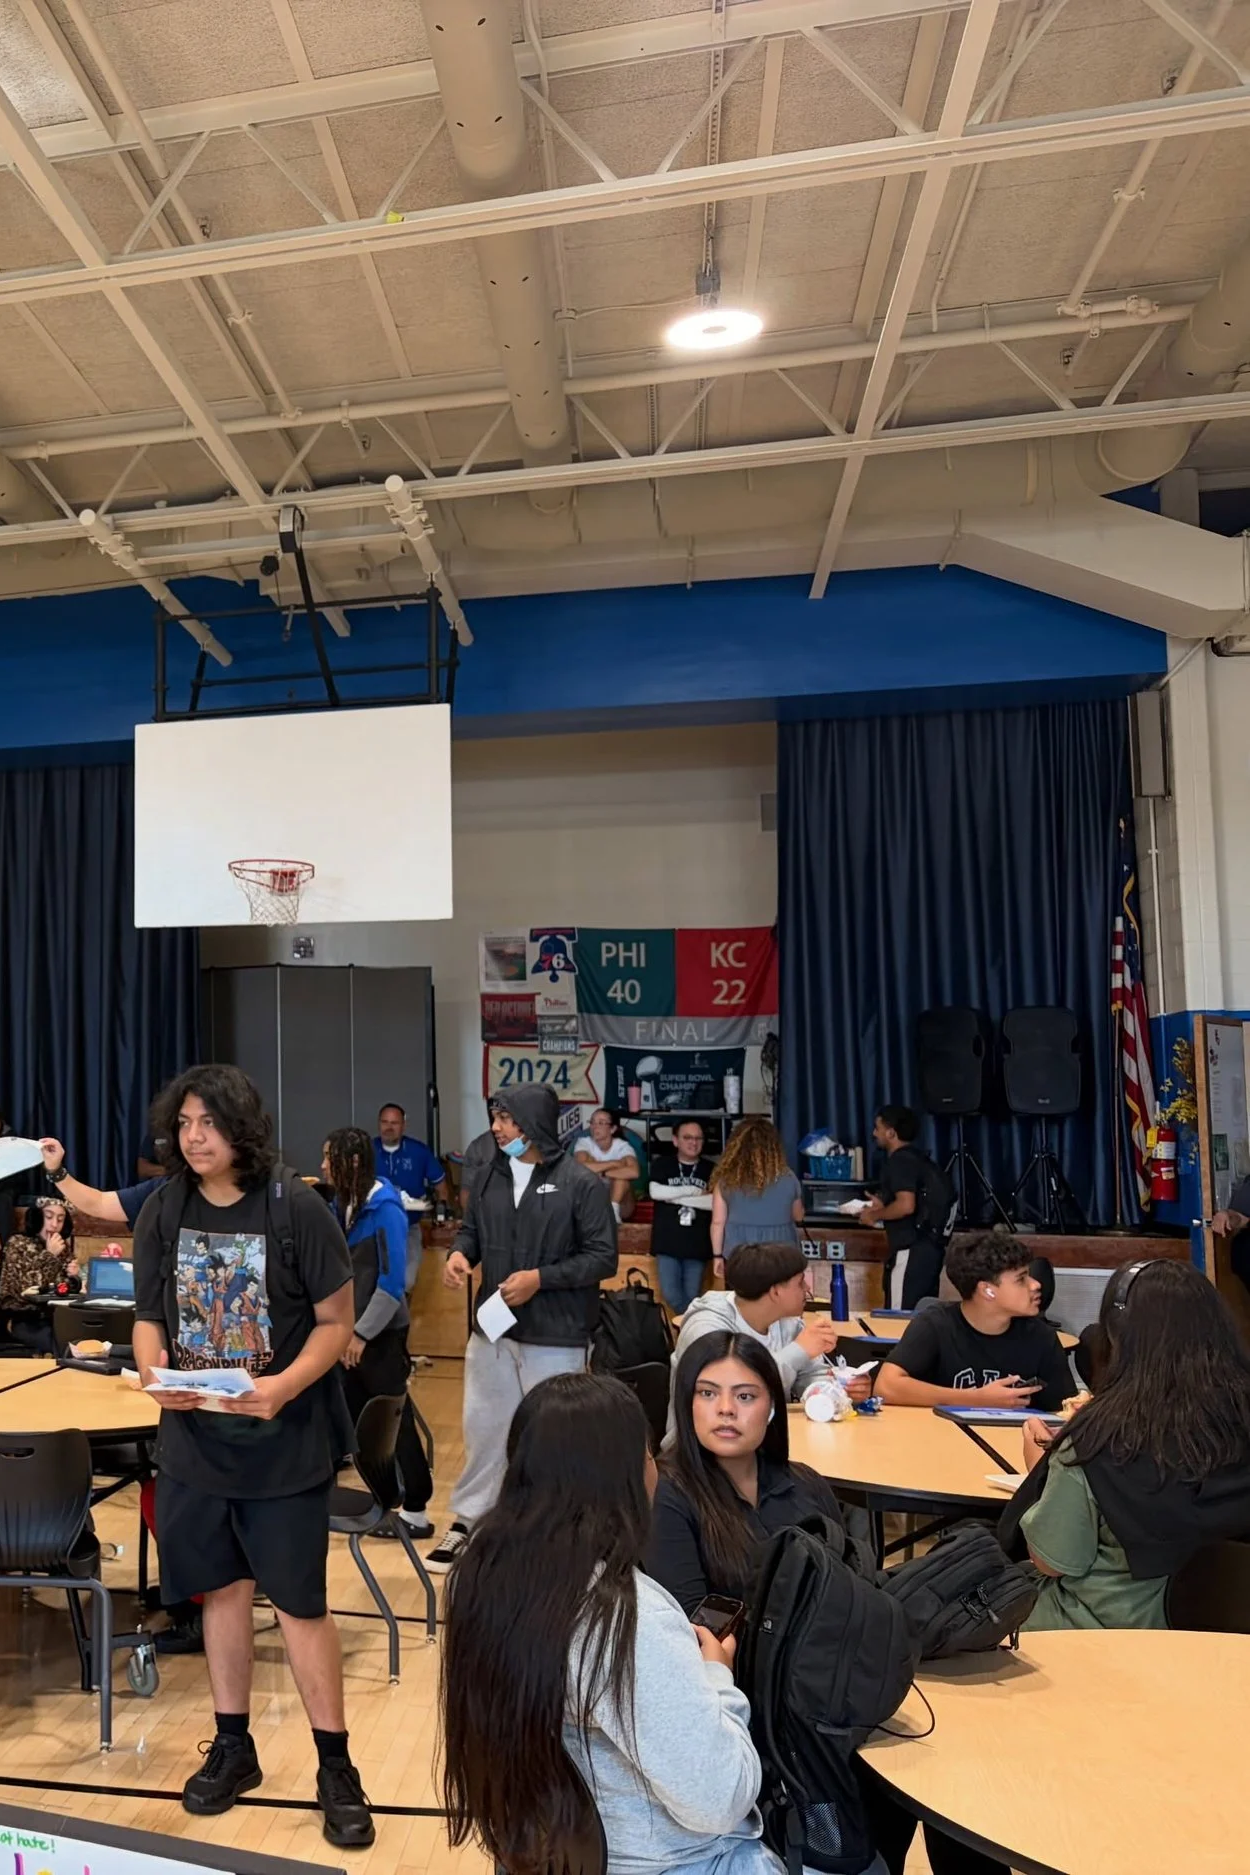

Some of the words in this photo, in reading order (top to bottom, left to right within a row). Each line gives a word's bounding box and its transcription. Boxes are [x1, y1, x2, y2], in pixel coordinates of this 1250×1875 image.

[600, 942, 646, 968] PHI
[710, 942, 748, 968] KC
[606, 979, 641, 1004] 40
[712, 979, 746, 1005] 22
[635, 1020, 716, 1041] FINAL
[498, 1057, 572, 1090] 2024
[15, 1832, 56, 1853] hate!
